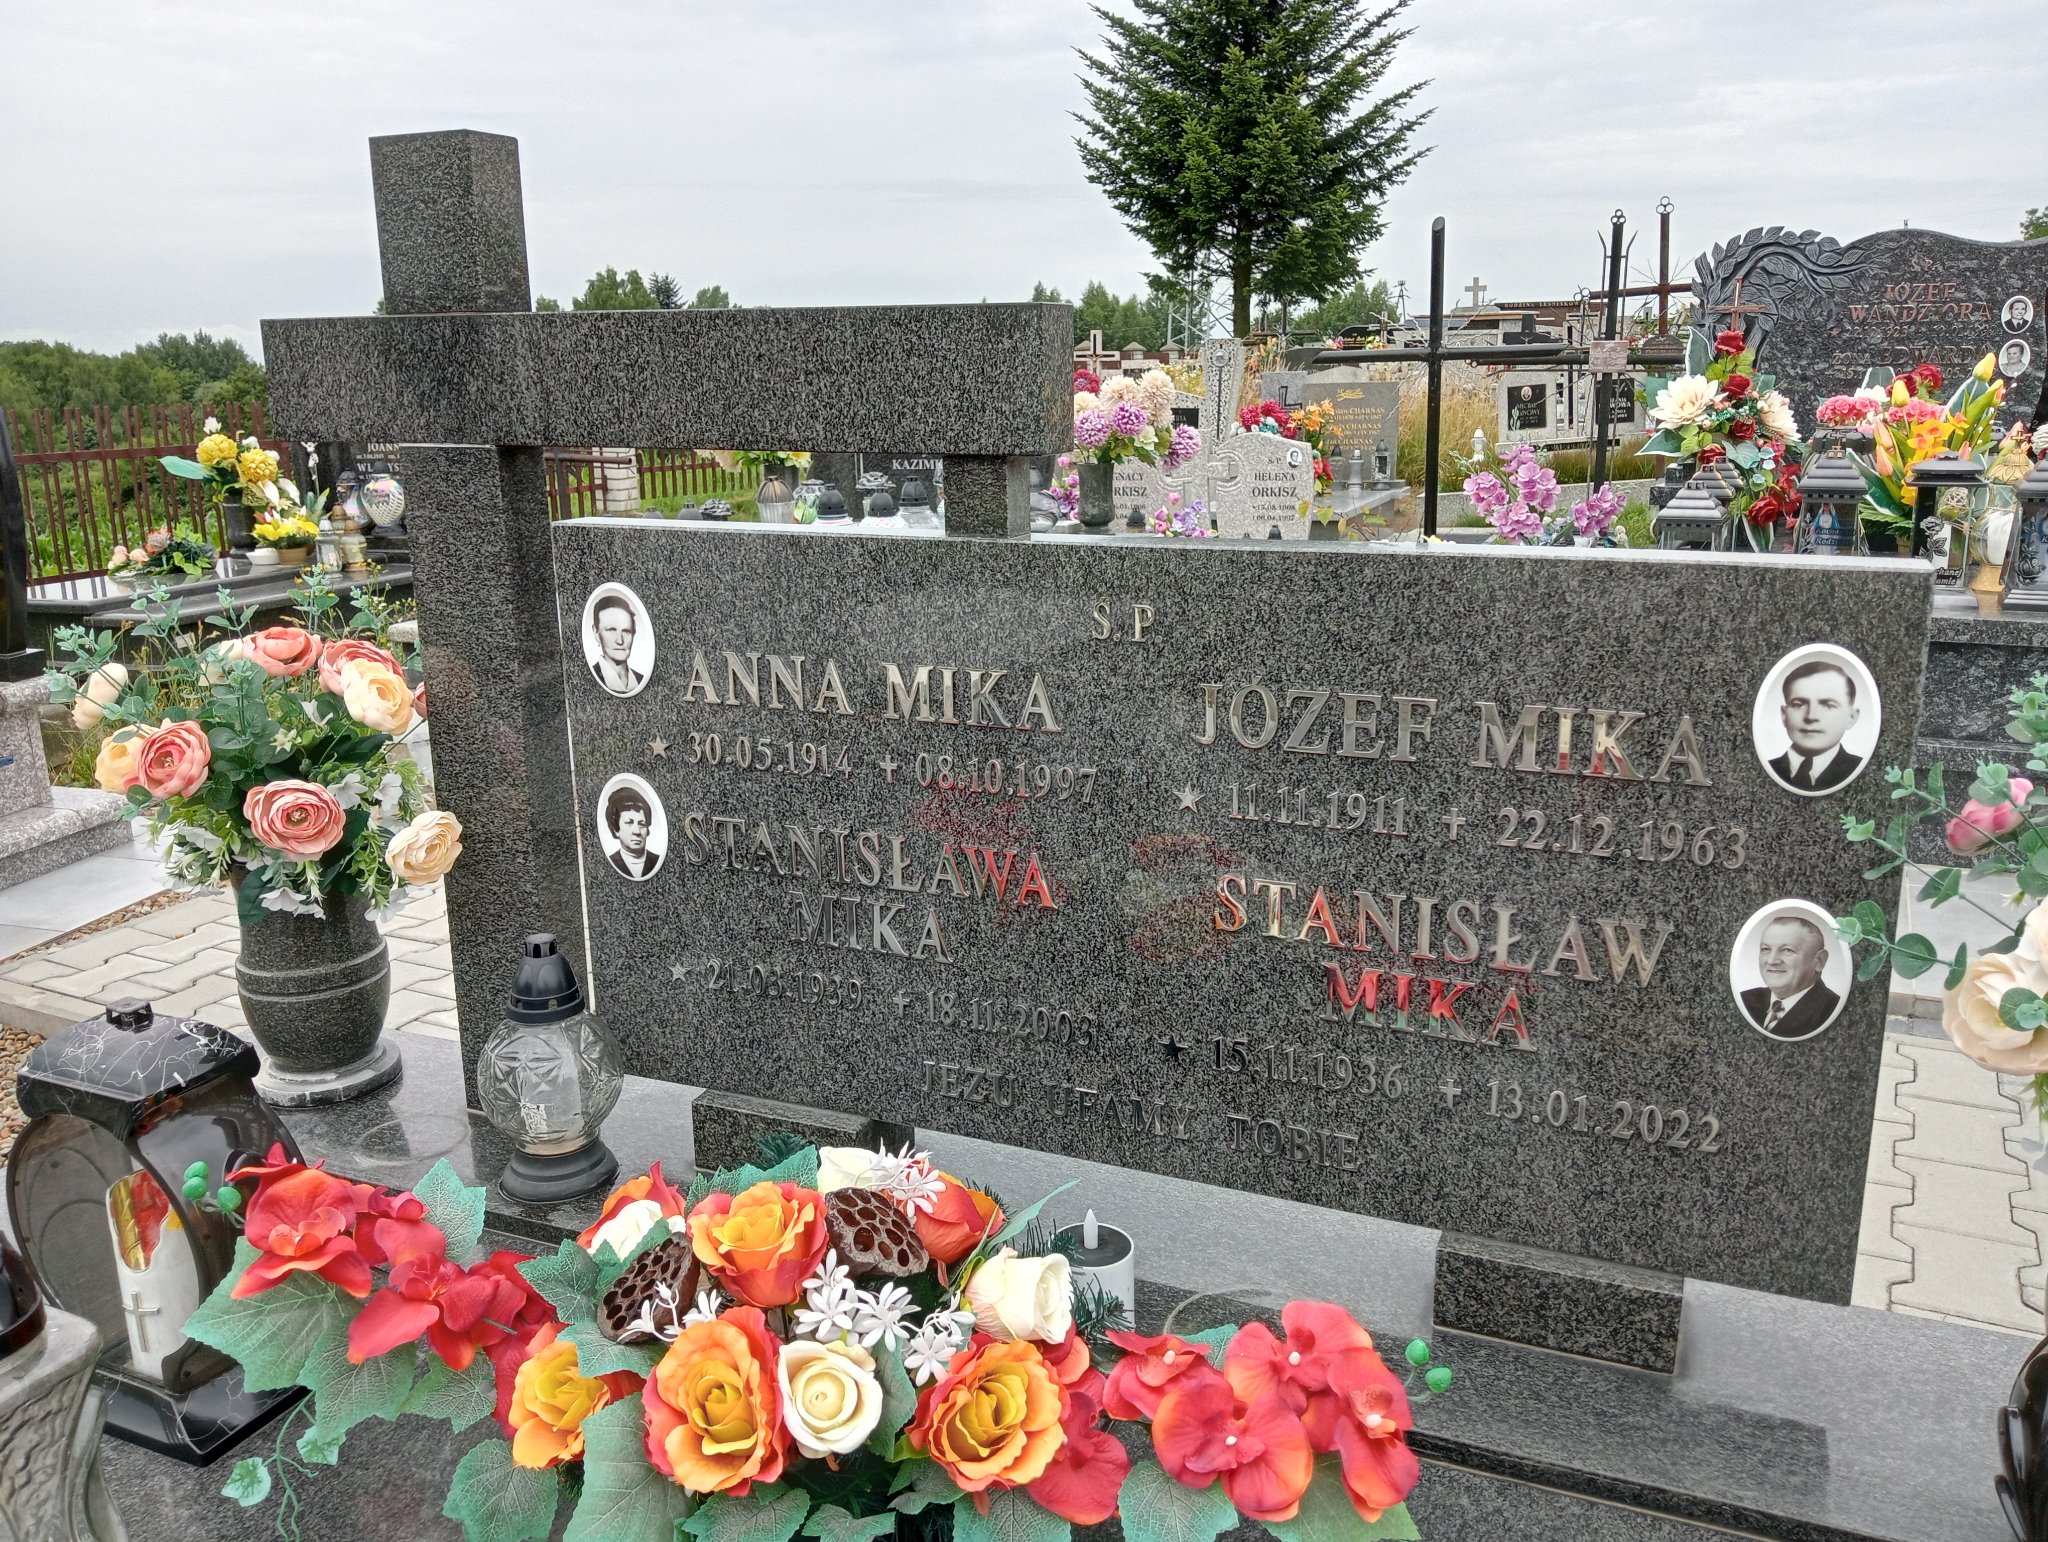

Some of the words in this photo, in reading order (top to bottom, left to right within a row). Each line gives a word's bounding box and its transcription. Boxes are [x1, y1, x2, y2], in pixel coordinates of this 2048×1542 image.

[367, 442, 400, 453] JOANN
[892, 459, 944, 470] KAZIM
[1254, 473, 1296, 481] HELENA
[1113, 486, 1148, 497] RKISZ
[1252, 487, 1297, 498] ORKISZ
[683, 649, 855, 716] ANNA
[882, 661, 1063, 733] MIKA
[1195, 676, 1439, 762] JÓZEF
[1470, 700, 1713, 787] MIKA
[687, 731, 853, 779] 30.05.1914
[915, 753, 1098, 803] 08.10.1997
[684, 812, 1060, 910] STANISŁAWA
[1229, 781, 1409, 836] 11.11.1911
[1499, 807, 1747, 869] 22.12.1963
[789, 890, 955, 965] MIKA
[1214, 873, 1674, 988] STANISŁAW
[1318, 961, 1537, 1052] MIKA
[922, 1059, 1016, 1109] JEZU
[1226, 1113, 1361, 1171] TOBIE
[1211, 1035, 1403, 1099] 15.11.1936
[1486, 1078, 1721, 1153] 13.01.2022
